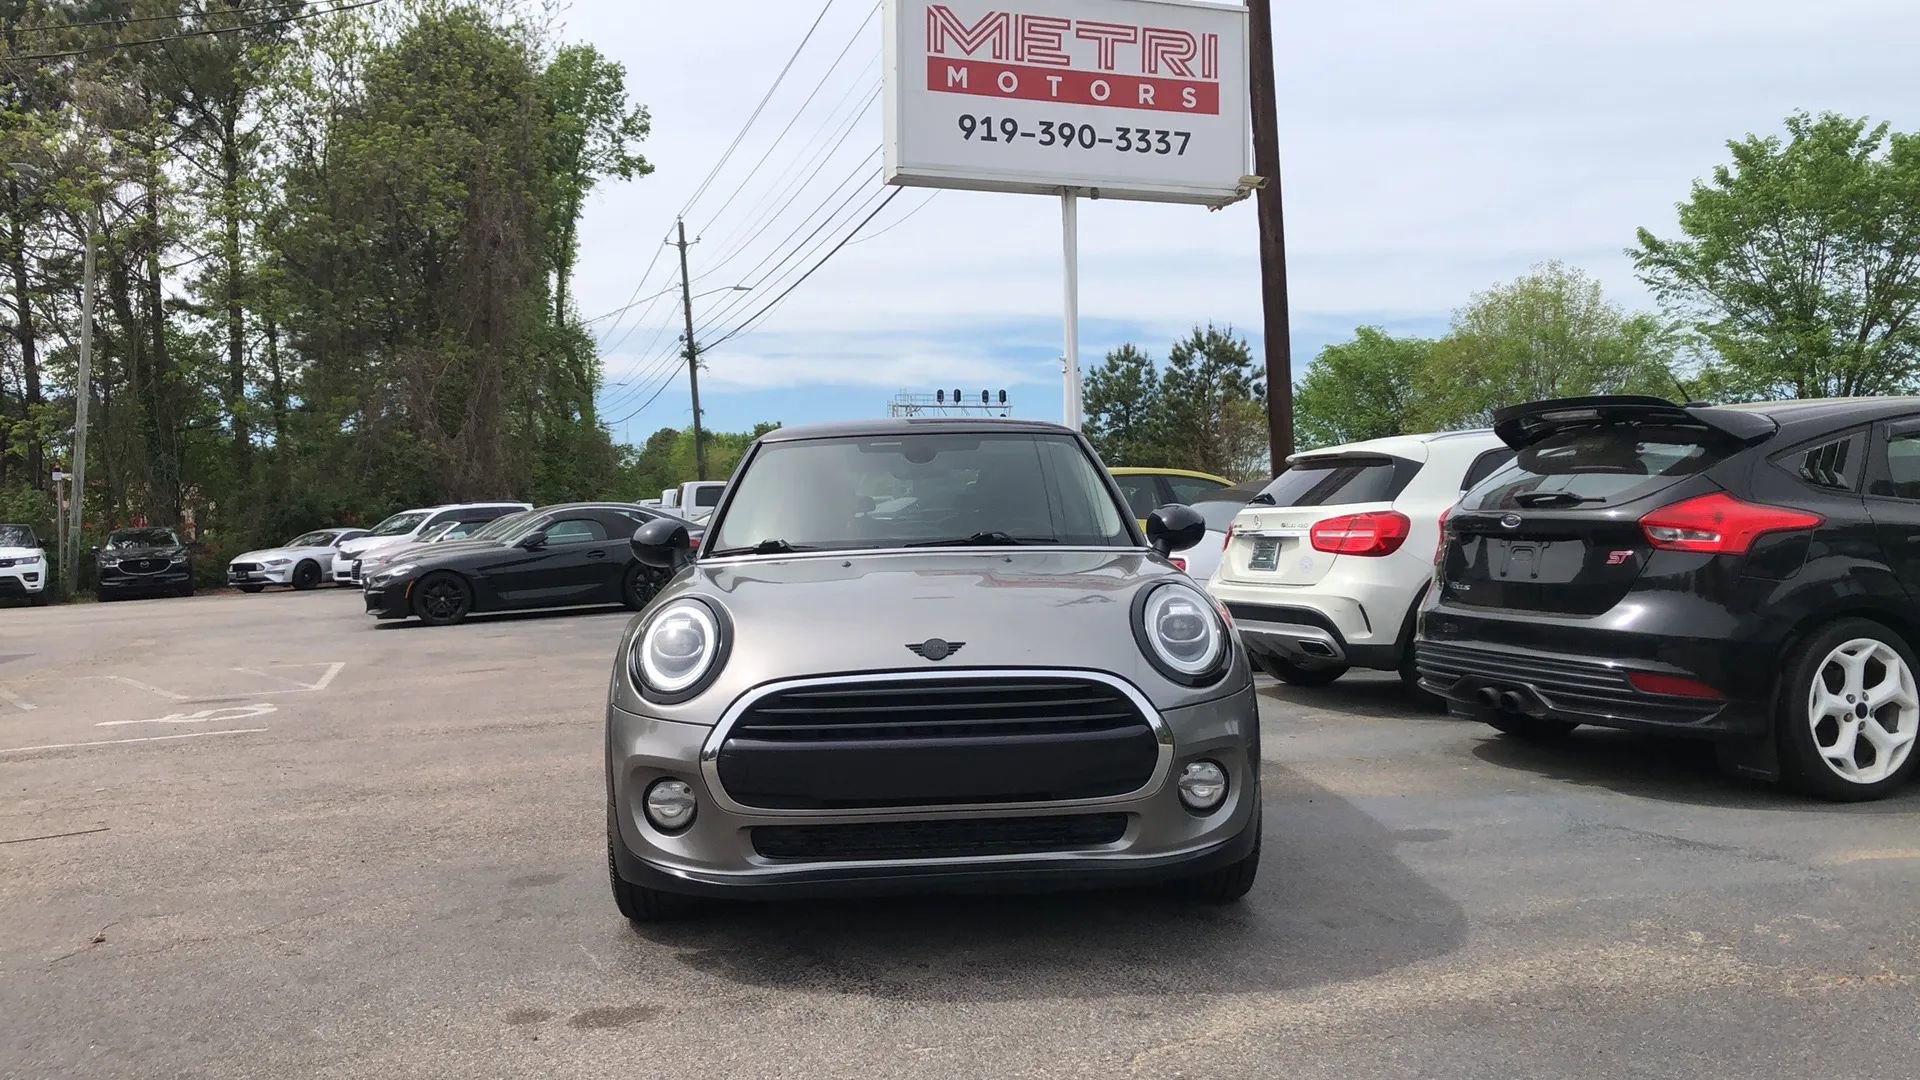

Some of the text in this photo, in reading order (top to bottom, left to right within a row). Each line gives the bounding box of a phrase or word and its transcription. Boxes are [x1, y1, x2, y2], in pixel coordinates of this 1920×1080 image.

[927, 5, 1218, 79] METRI
[947, 66, 1197, 108] MOTORS
[958, 114, 1191, 156] 919-390-3337
[1606, 550, 1634, 565] ST
